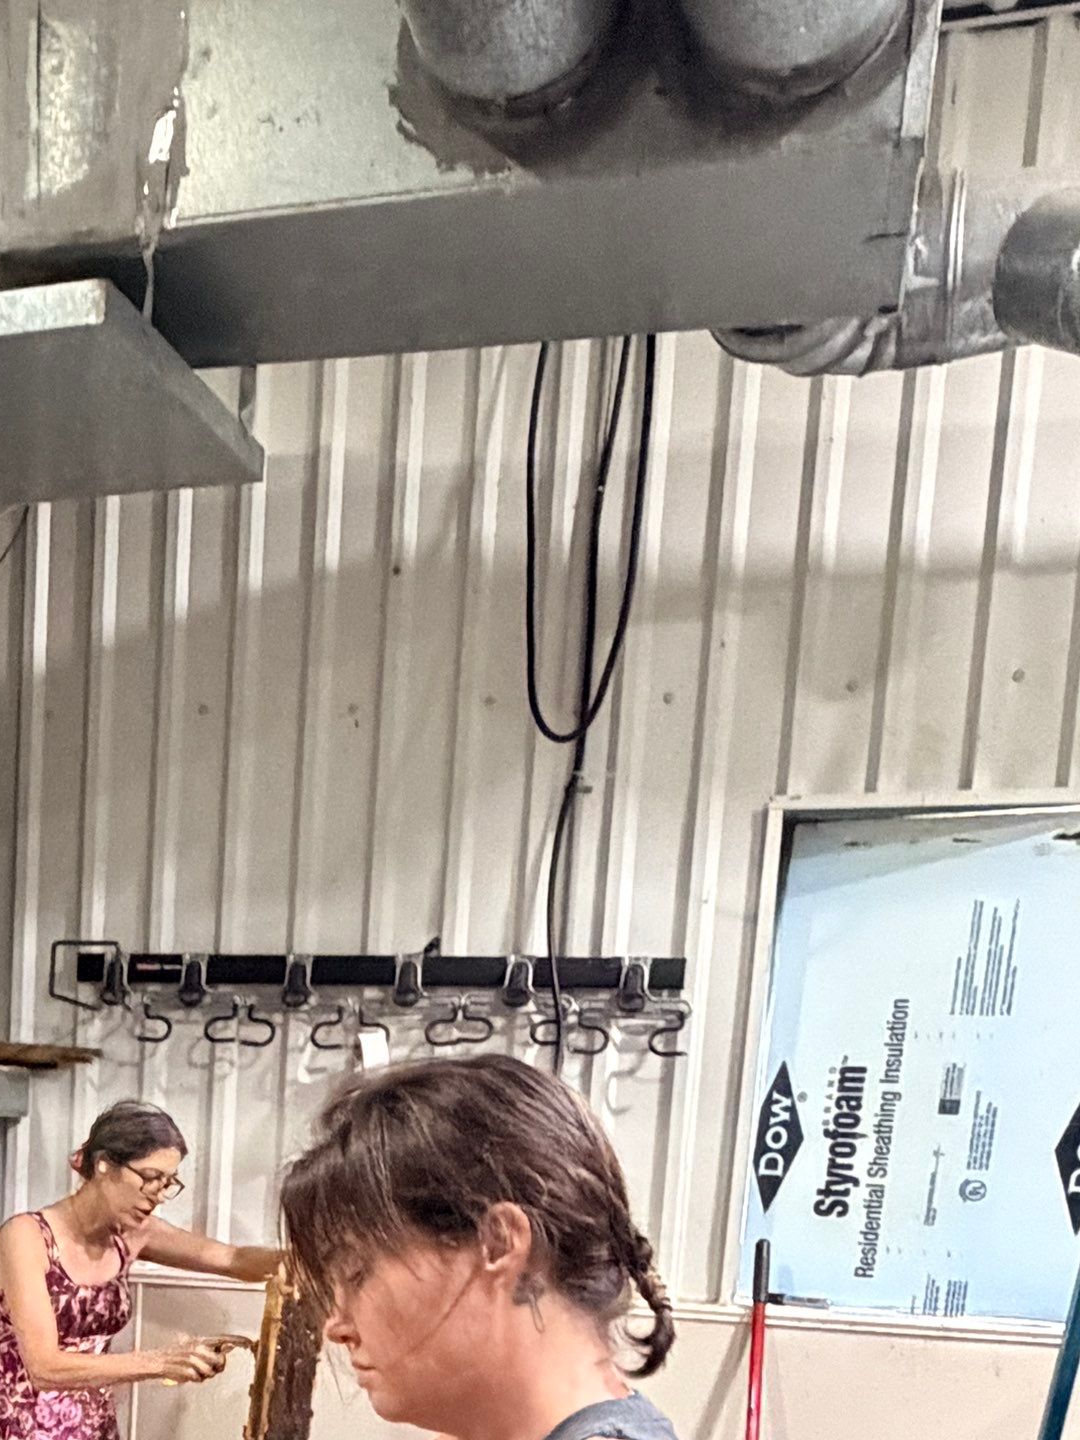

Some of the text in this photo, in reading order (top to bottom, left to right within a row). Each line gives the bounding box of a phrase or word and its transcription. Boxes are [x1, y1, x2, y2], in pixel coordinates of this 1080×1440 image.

[813, 1065, 869, 1218] Styrofoam
[854, 998, 911, 1279] Residential Sheathing Insulation
